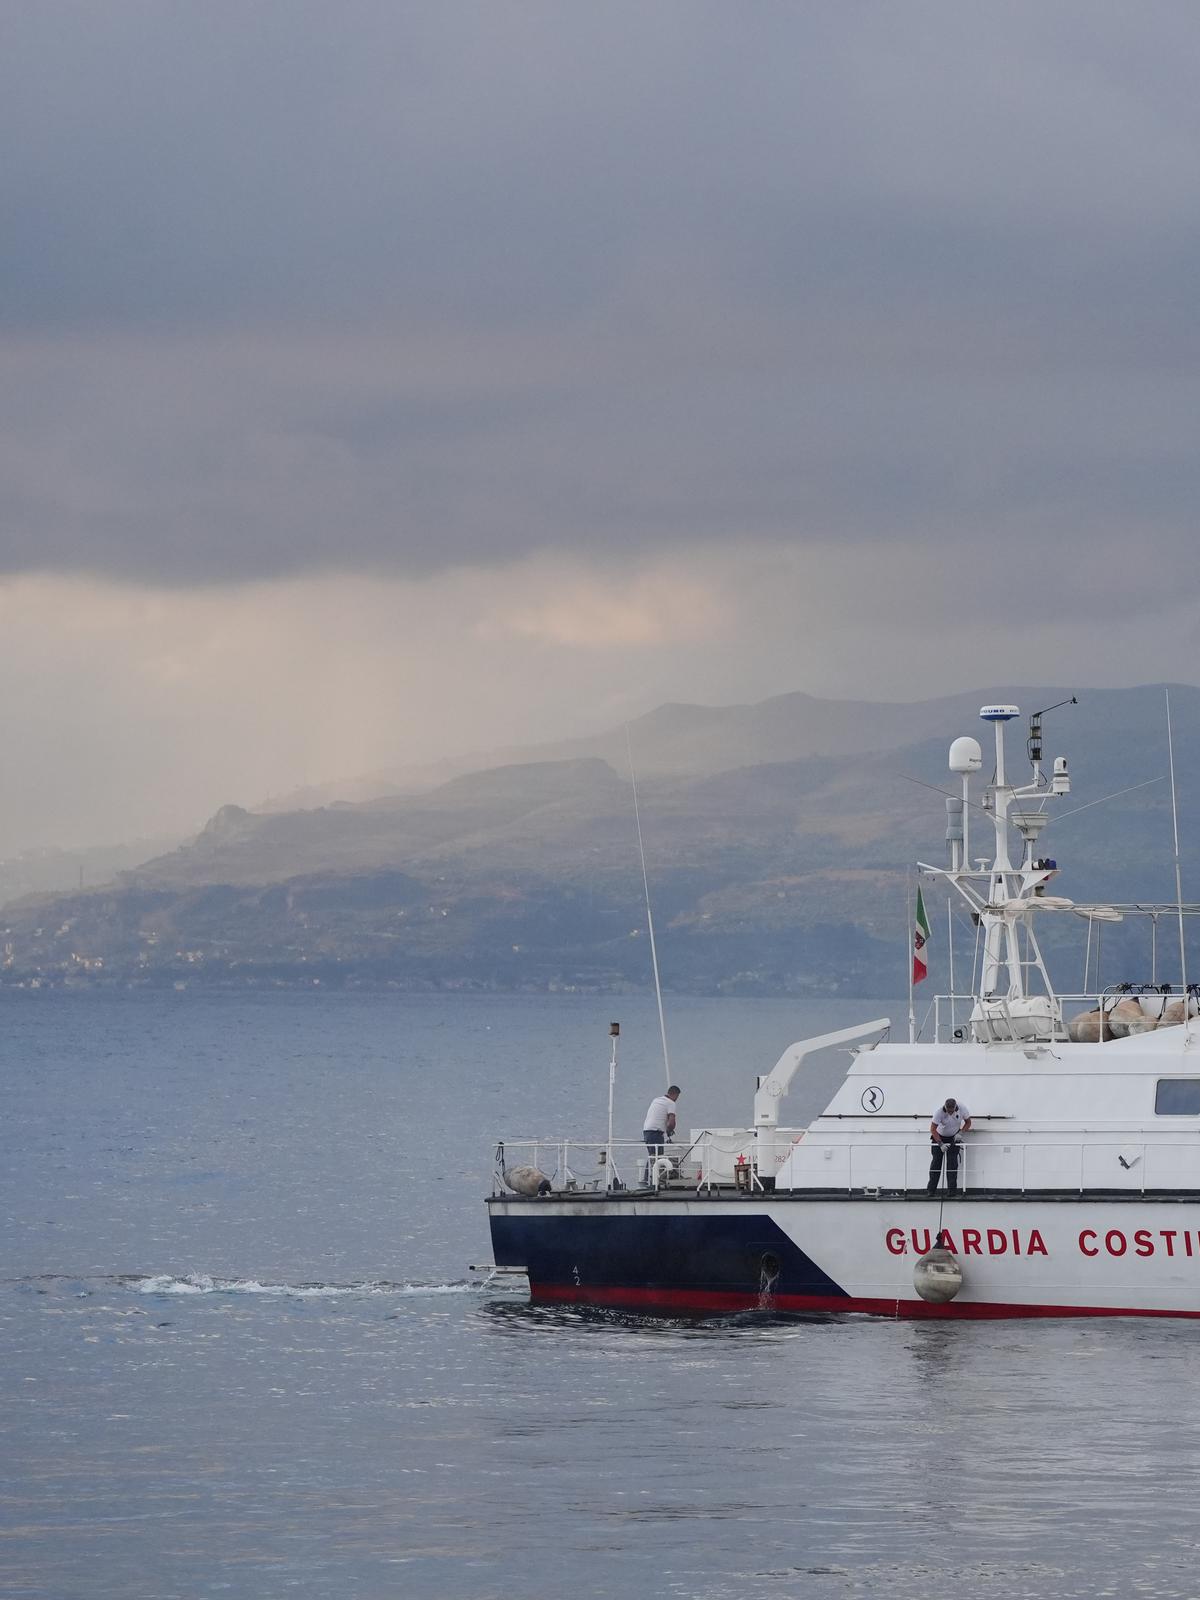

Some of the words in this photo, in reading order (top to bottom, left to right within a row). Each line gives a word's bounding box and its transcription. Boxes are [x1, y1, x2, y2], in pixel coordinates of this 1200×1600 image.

[886, 1228, 1049, 1256] GUARDIA
[572, 1265, 579, 1275] 4
[574, 1275, 581, 1286] 2
